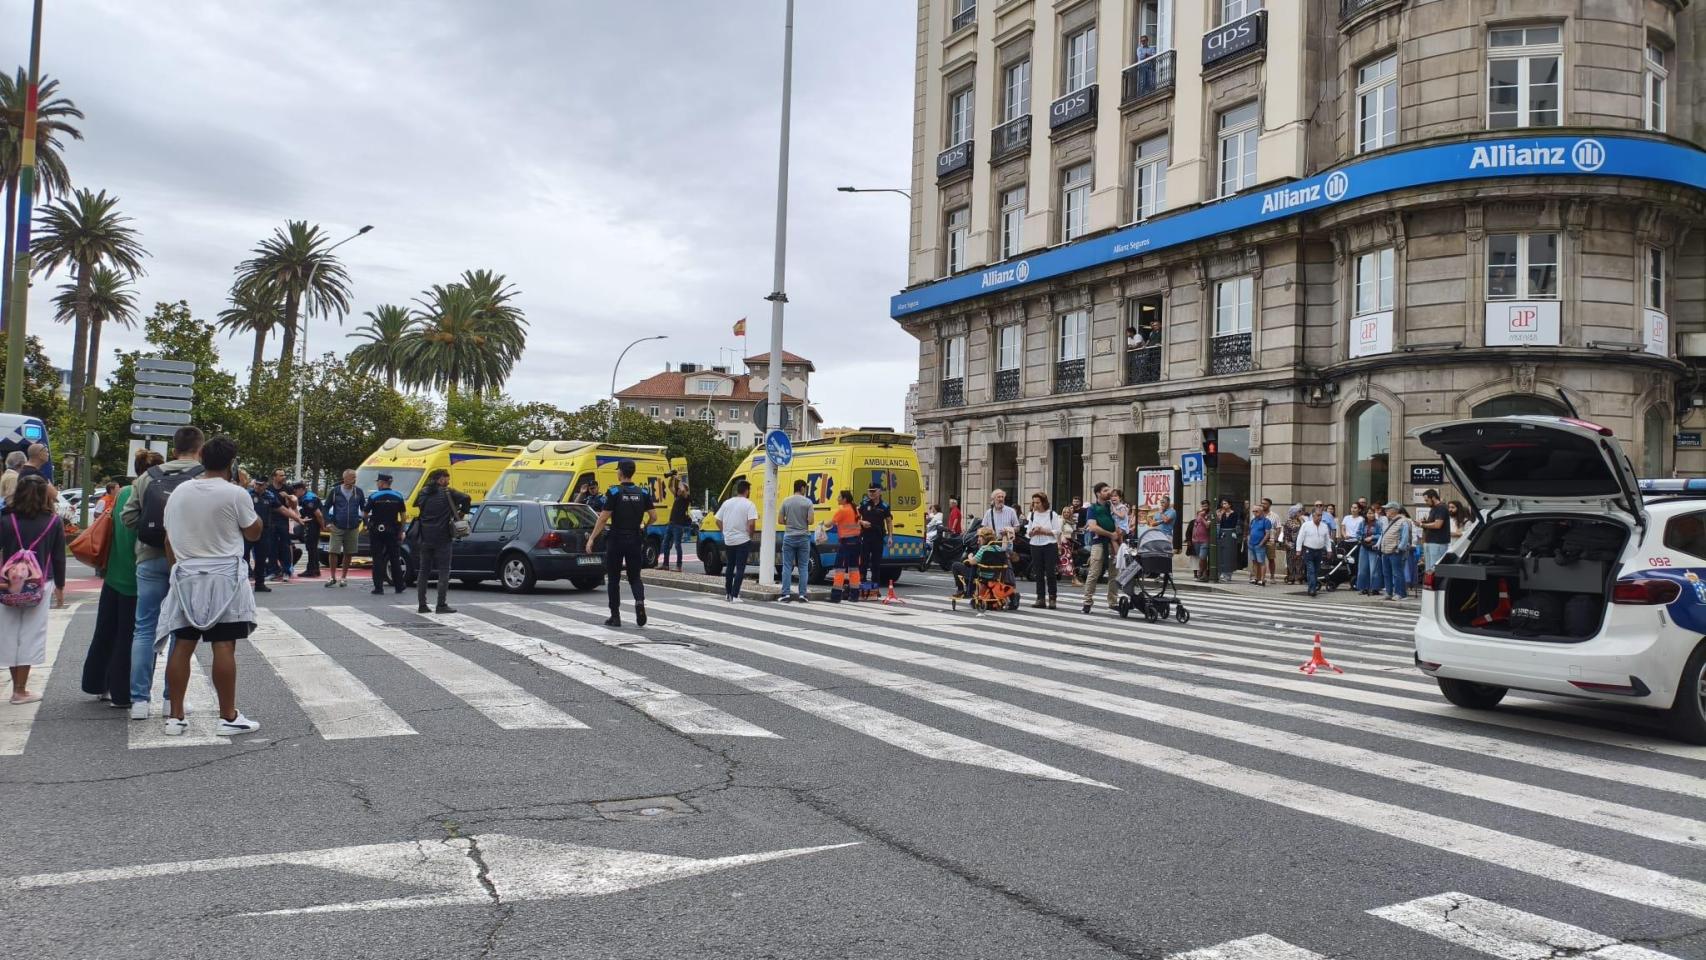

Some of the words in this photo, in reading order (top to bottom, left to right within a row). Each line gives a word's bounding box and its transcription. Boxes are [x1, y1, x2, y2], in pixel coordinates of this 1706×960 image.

[1207, 21, 1250, 49] aps
[1054, 94, 1086, 116] aps
[940, 148, 964, 167] aps
[1469, 139, 1565, 169] Allianz
[1261, 183, 1321, 215] Allianz
[981, 269, 1014, 288] Allianz
[863, 458, 910, 468] AMBULANCIA
[1184, 456, 1198, 479] P
[1413, 467, 1440, 477] aps
[1143, 474, 1171, 493] BURGERS
[1648, 557, 1671, 567] 092
